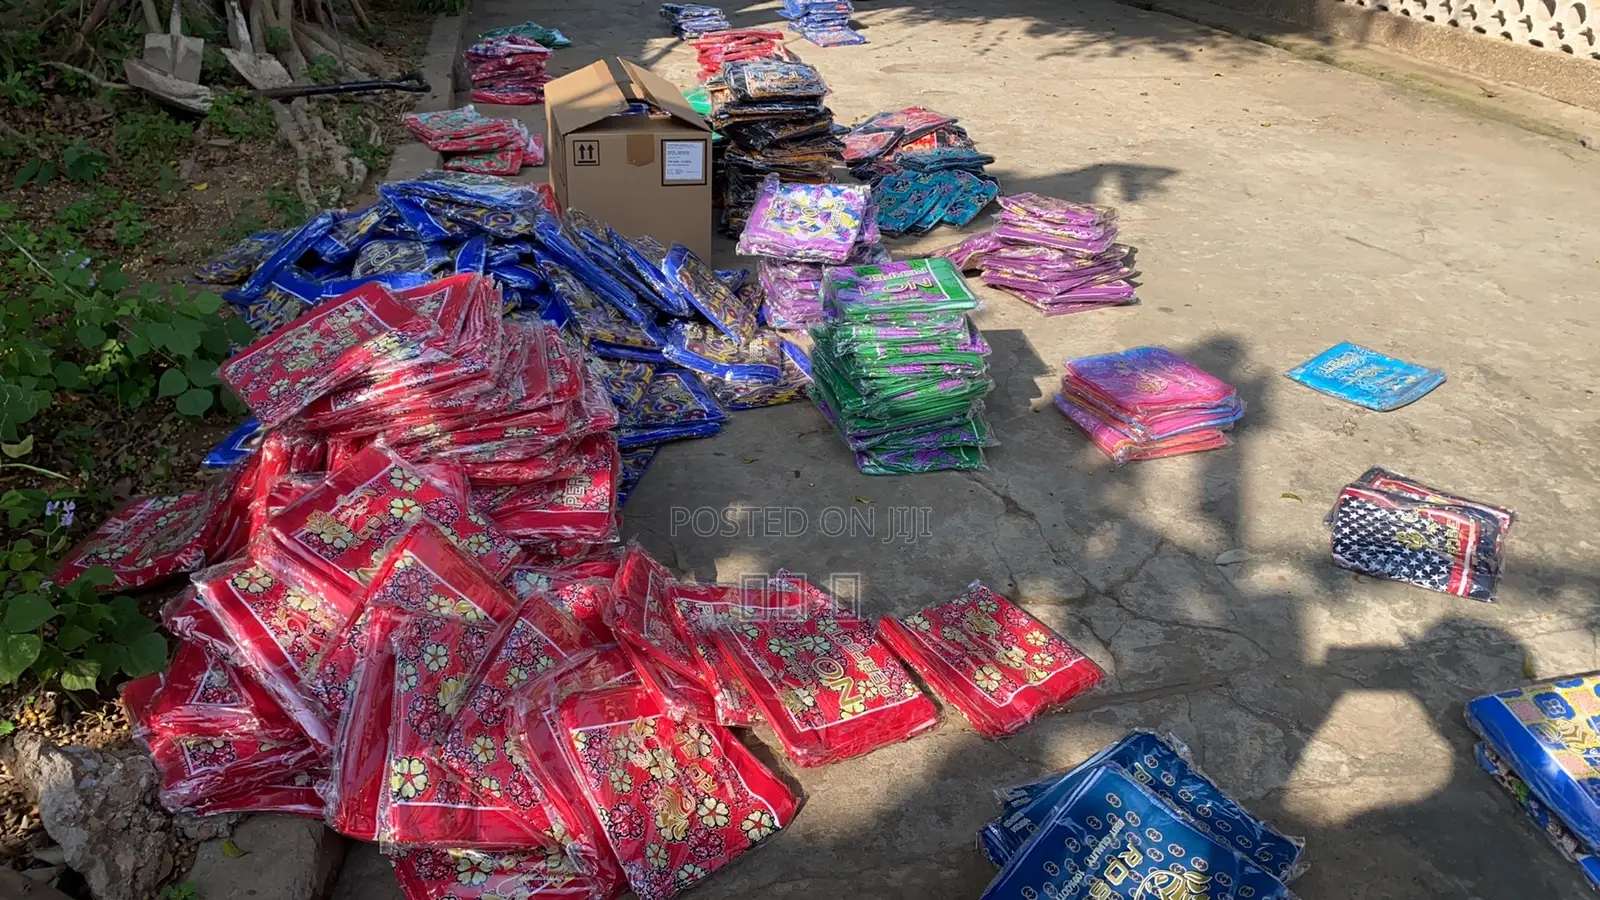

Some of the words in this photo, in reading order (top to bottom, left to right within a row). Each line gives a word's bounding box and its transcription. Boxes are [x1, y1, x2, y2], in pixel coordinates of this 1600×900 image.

[825, 630, 897, 697] PERFECT
[1083, 843, 1144, 900] ROS
[1085, 837, 1112, 867] QUALITY
